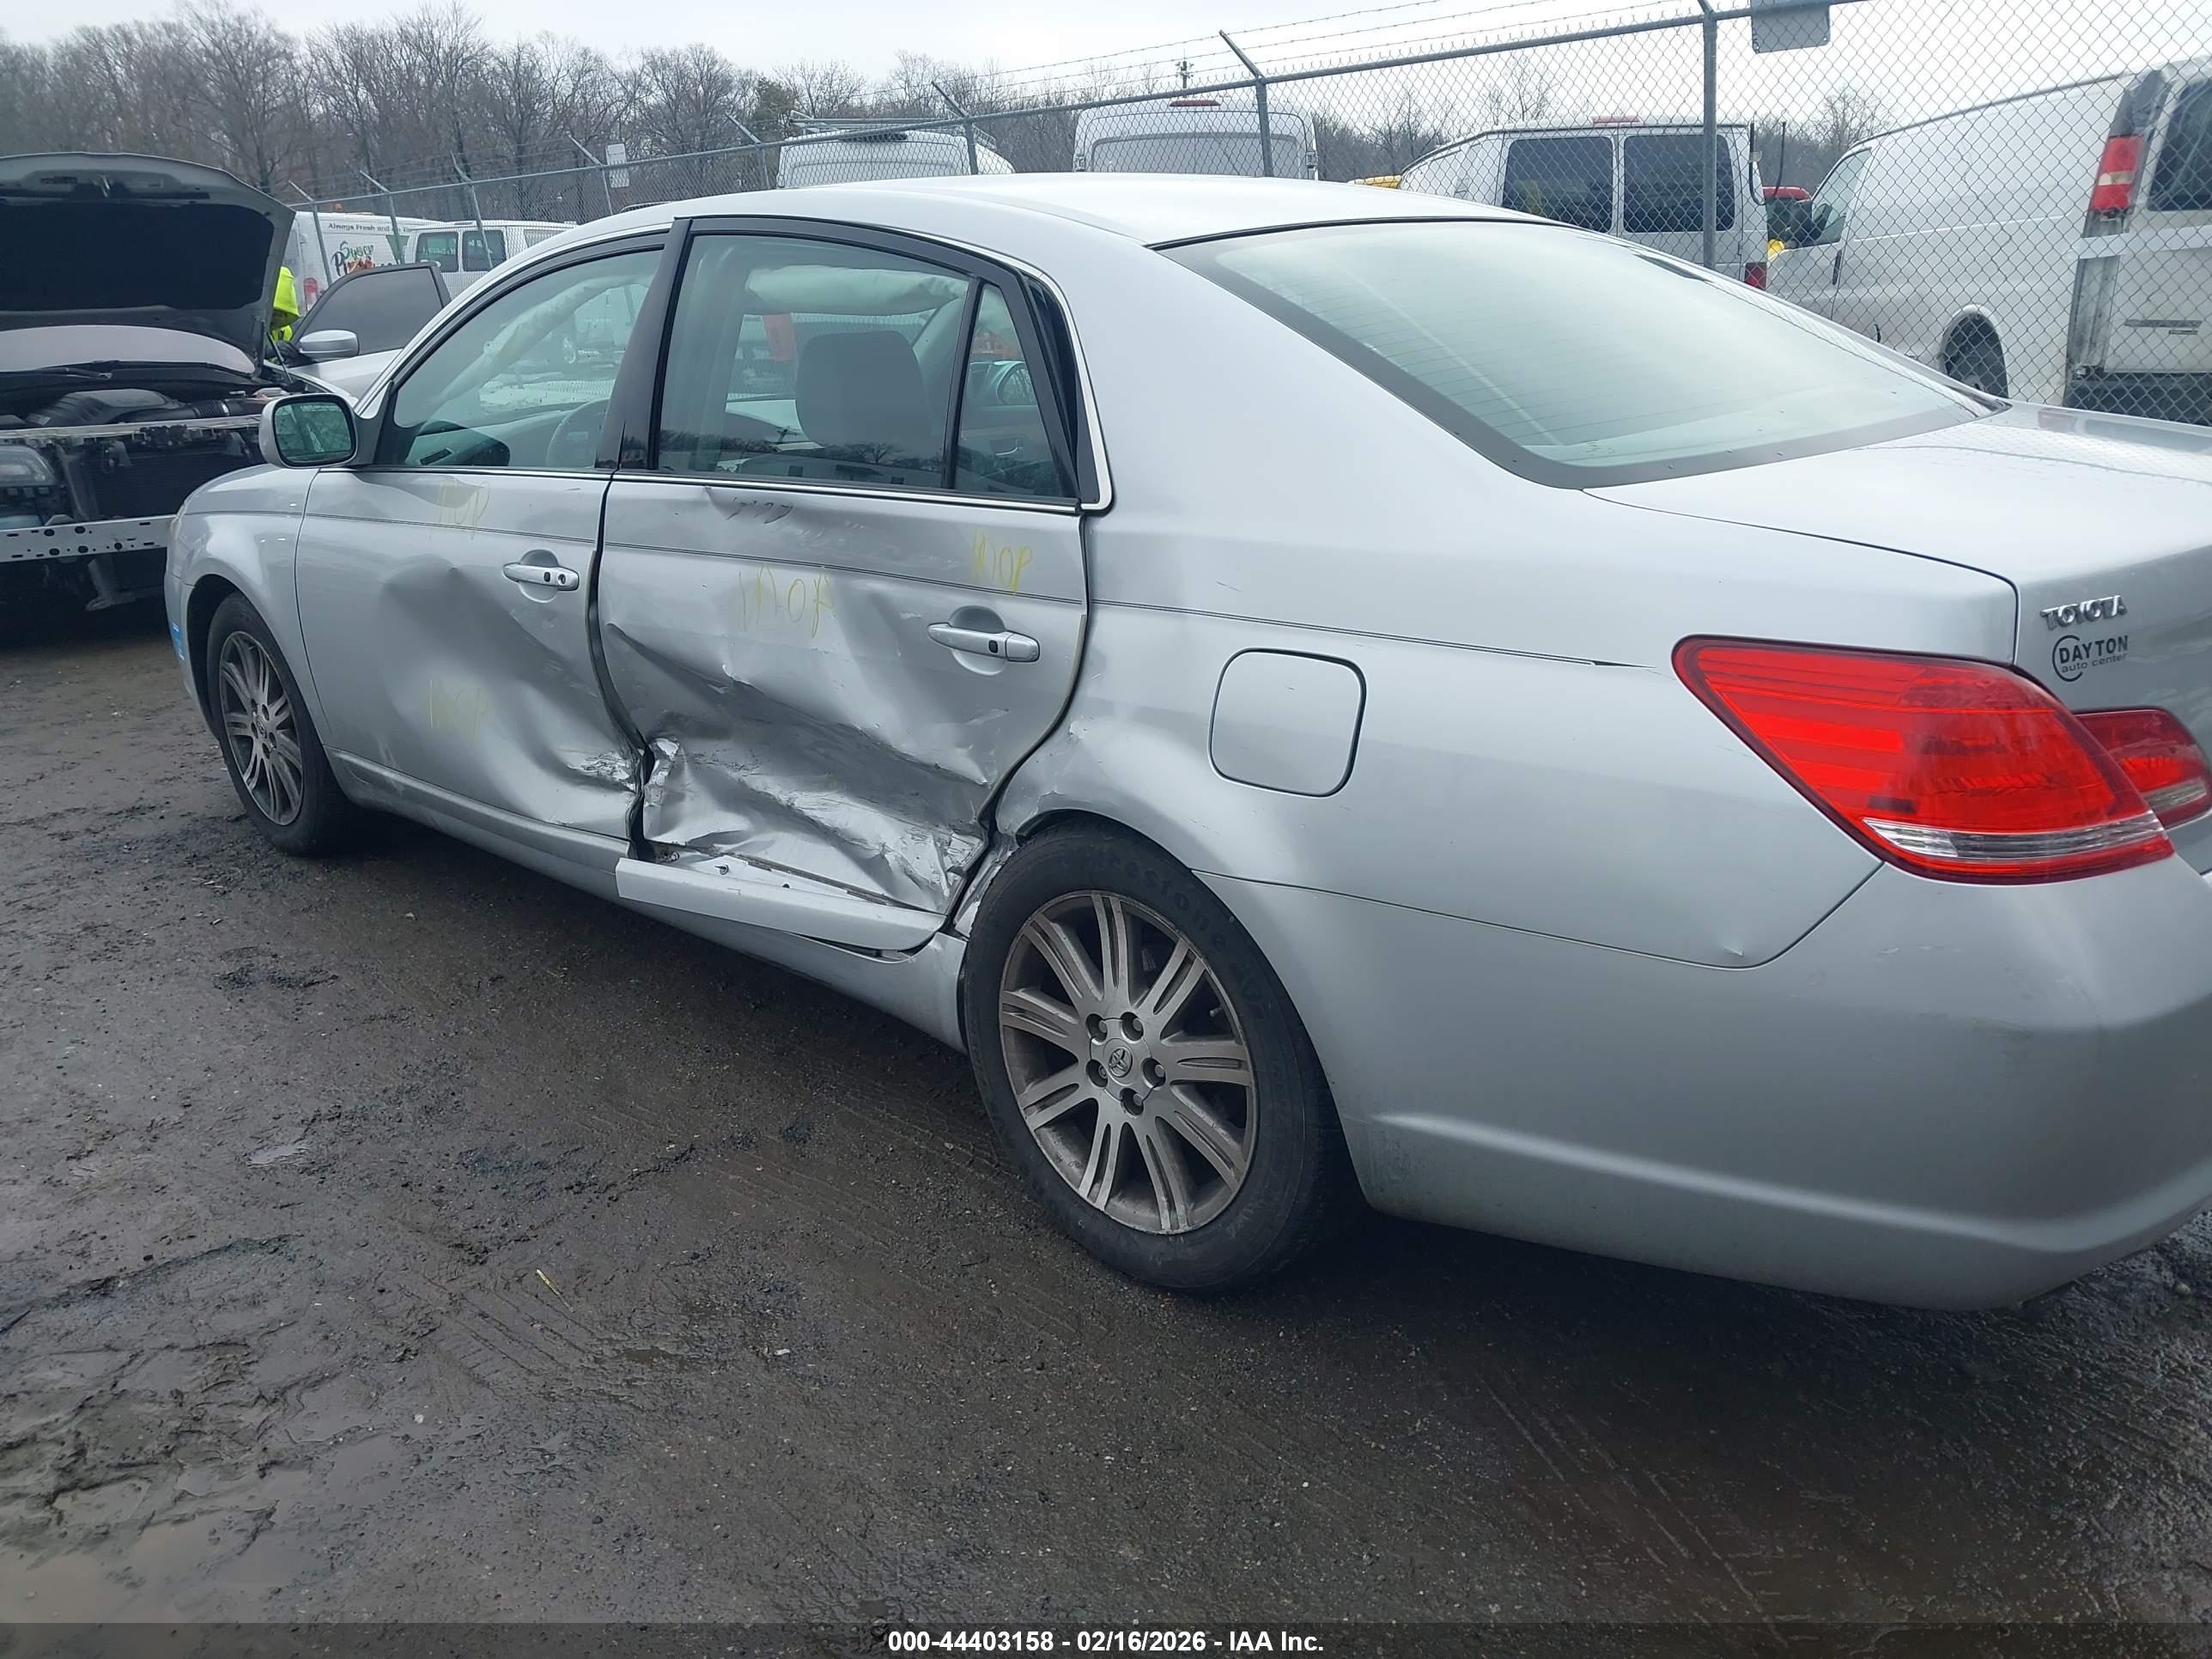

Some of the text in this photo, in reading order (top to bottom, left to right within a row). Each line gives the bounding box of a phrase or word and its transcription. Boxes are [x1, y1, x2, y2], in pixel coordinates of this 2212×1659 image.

[2040, 595, 2128, 630] TOYOTA
[2059, 635, 2128, 664] DAYTON
[2061, 653, 2128, 673] auto center
